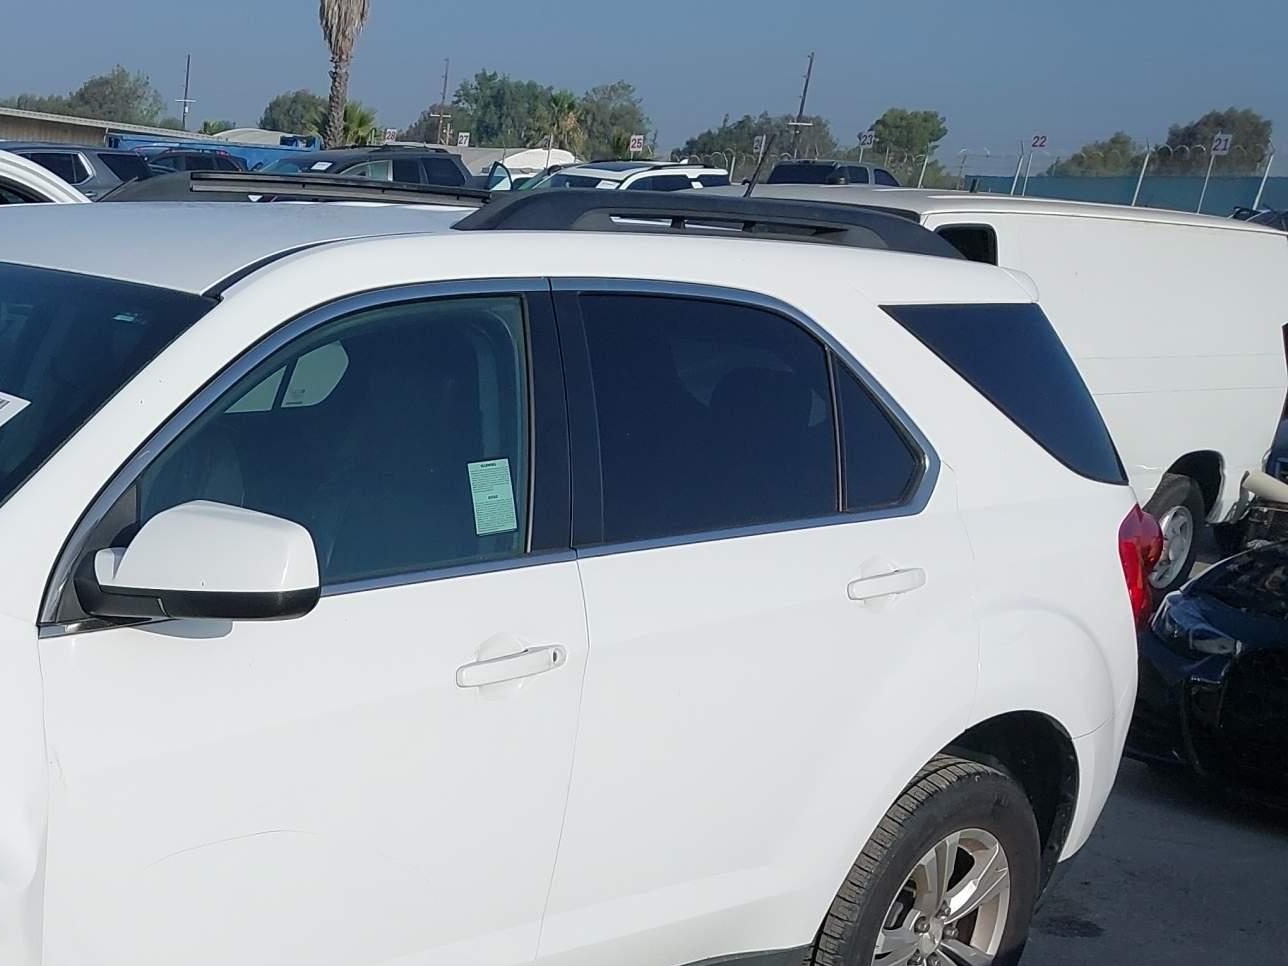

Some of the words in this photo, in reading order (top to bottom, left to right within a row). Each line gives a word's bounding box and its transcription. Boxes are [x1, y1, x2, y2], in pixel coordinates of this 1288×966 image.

[458, 134, 469, 145] 27
[630, 138, 643, 149] 25
[860, 134, 873, 146] 23
[1031, 136, 1047, 147] 22
[1213, 137, 1229, 152] 21
